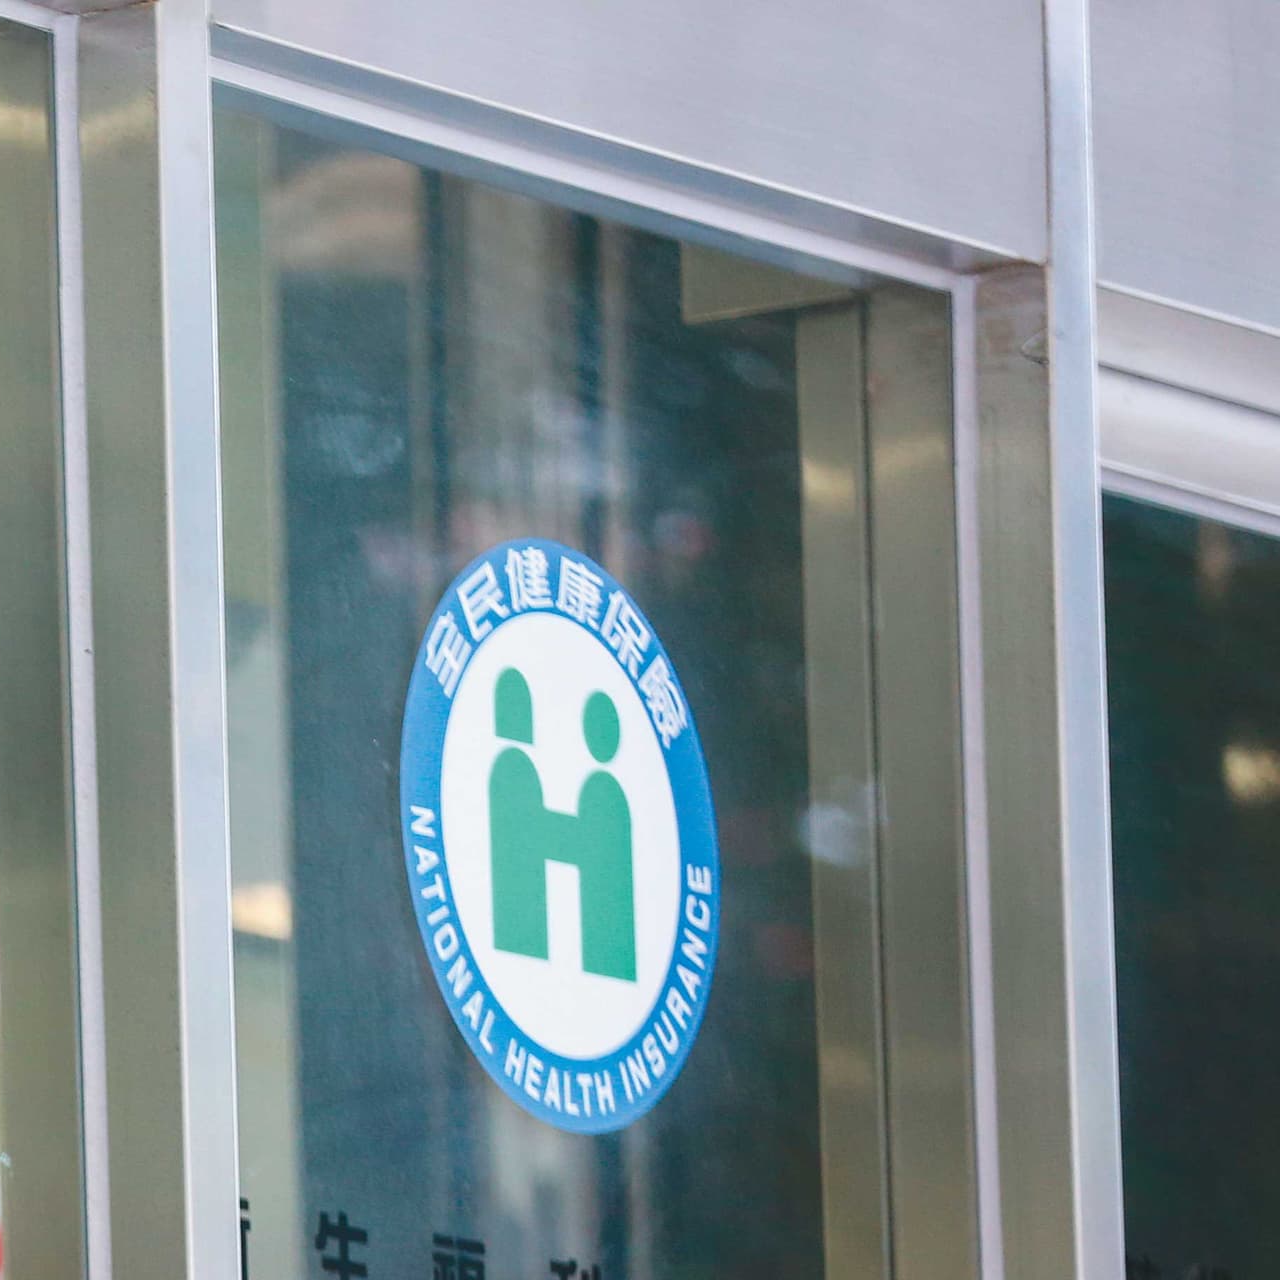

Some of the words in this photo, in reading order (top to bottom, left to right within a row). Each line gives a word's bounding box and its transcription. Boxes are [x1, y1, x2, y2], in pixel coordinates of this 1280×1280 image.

[424, 545, 688, 750] 全民健康保險
[410, 804, 494, 1053] NATIONAL
[504, 1038, 616, 1117] HEALTH
[619, 864, 711, 1104] INSURANCE
